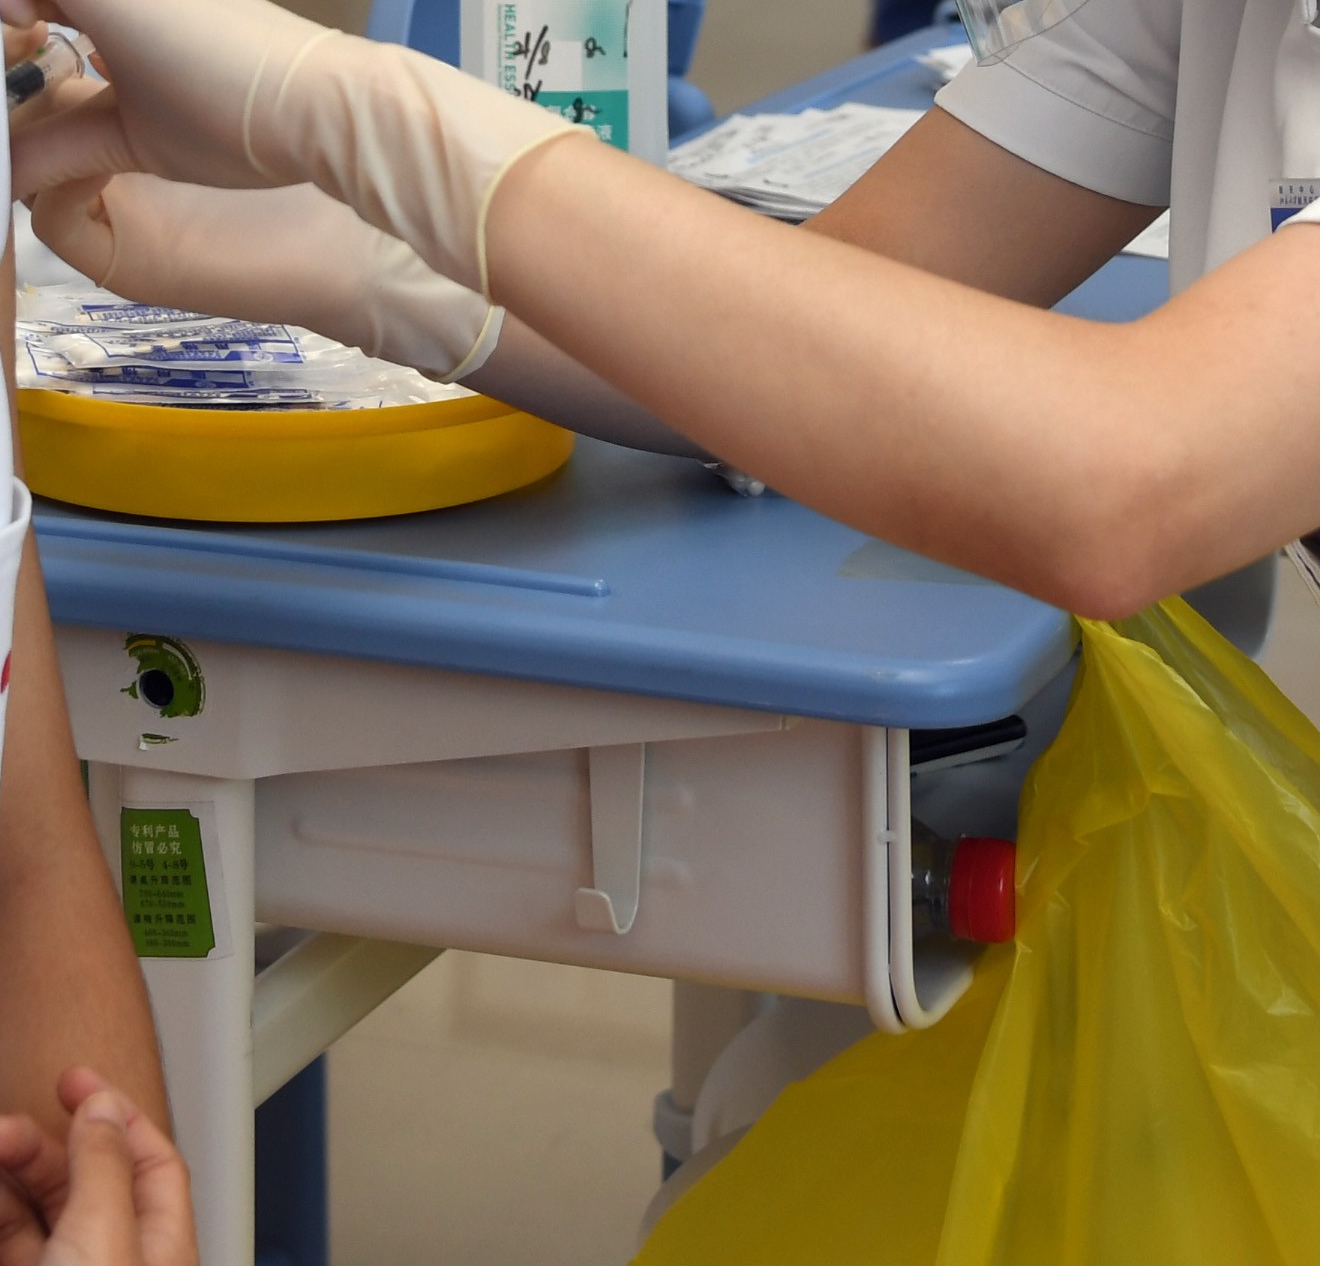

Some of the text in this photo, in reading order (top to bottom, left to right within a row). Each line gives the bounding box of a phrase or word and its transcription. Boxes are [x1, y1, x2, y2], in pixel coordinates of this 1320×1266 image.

[503, 3, 518, 95] HEALTH ESS
[130, 824, 180, 838] 专利产品
[132, 840, 182, 855] 仿冒必究
